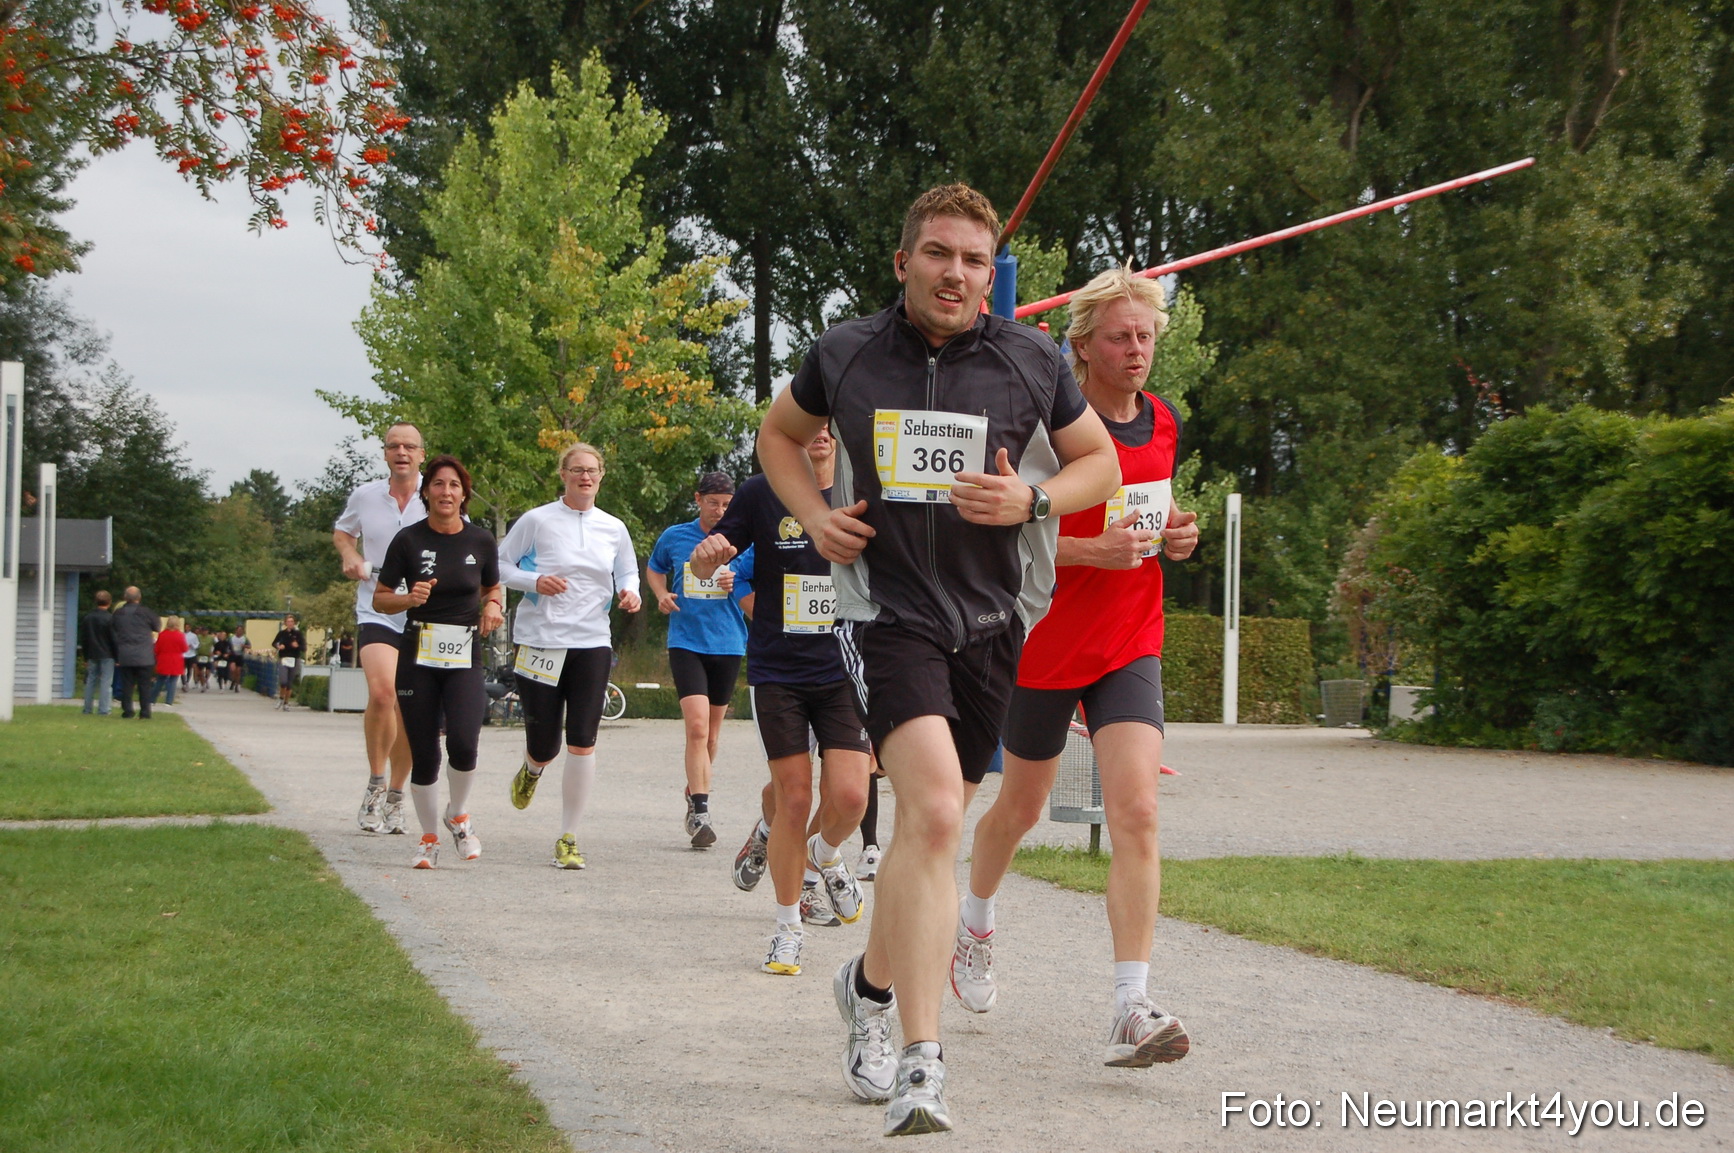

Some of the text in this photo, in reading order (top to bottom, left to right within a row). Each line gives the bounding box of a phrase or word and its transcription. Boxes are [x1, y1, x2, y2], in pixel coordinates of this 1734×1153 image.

[904, 419, 973, 439] Sebastian
[878, 445, 884, 457] B
[912, 447, 965, 473] 366
[1127, 491, 1149, 506] Albin
[1133, 511, 1162, 531] 639
[802, 580, 836, 593] Gerhar
[808, 599, 837, 615] 862
[438, 641, 463, 655] 992
[531, 654, 554, 671] 710
